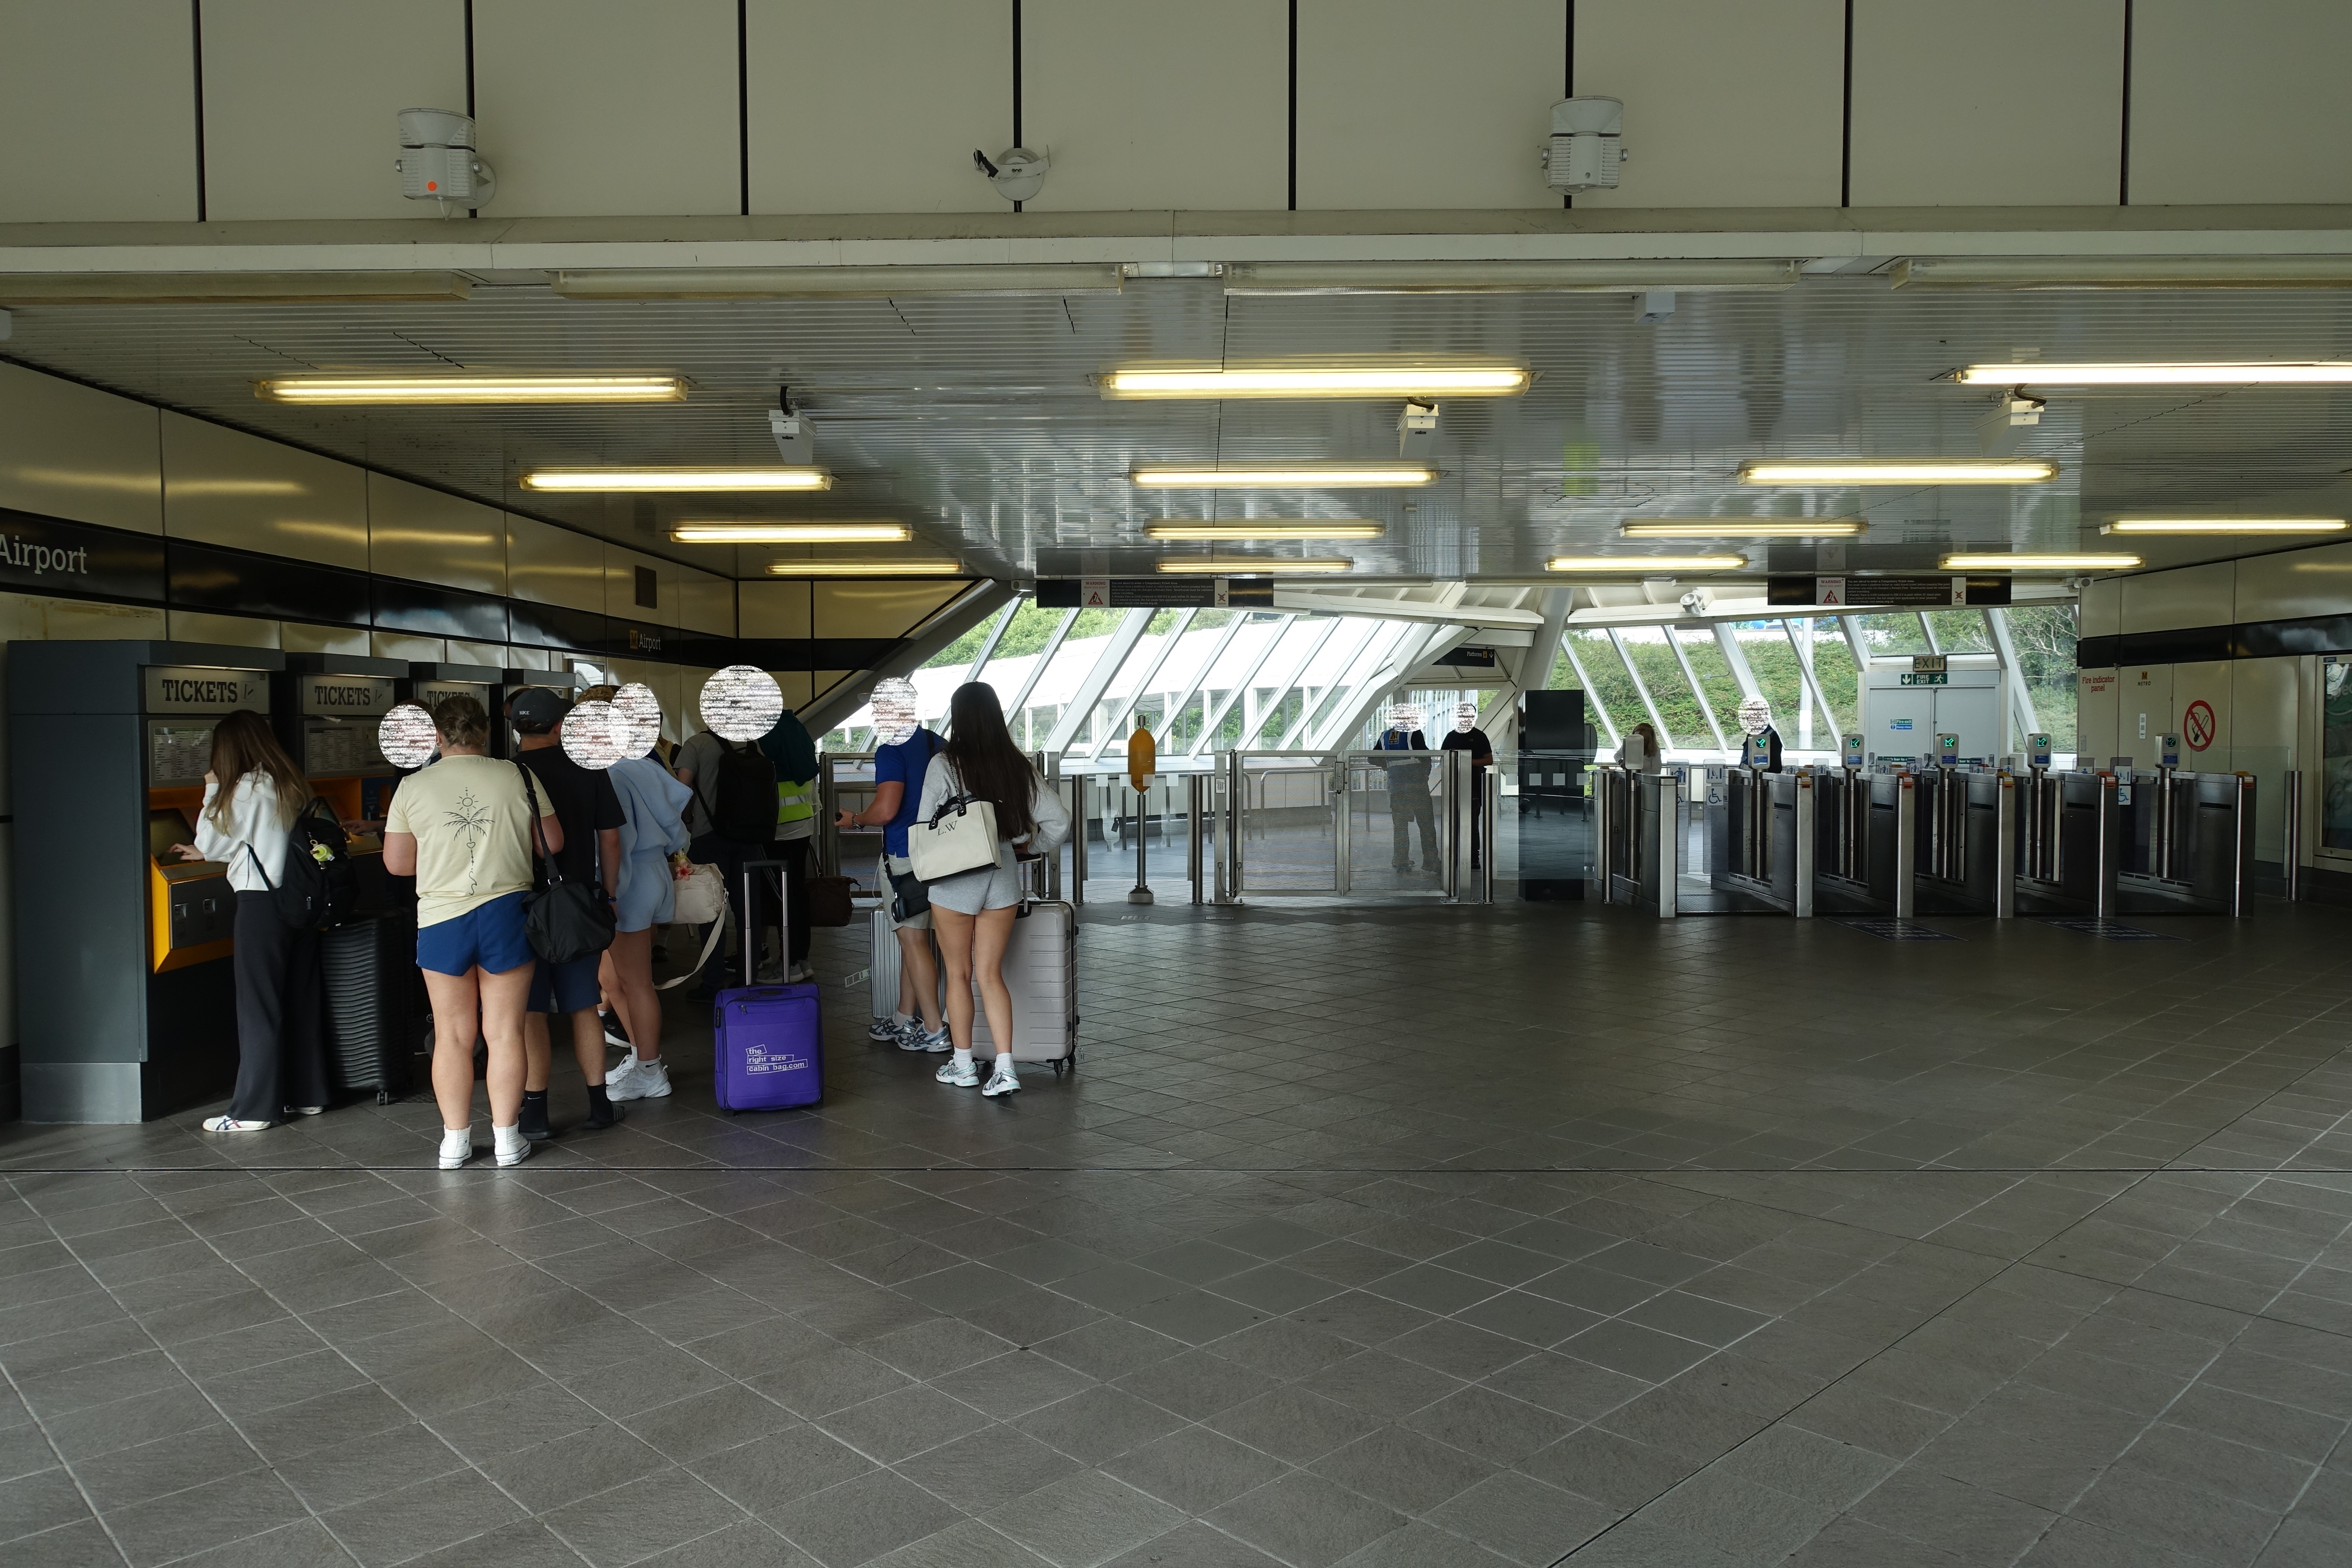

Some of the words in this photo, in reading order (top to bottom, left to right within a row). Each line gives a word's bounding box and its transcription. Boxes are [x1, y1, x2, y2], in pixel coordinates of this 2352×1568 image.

[0, 534, 87, 574] Airport
[639, 634, 661, 652] Airport
[1914, 658, 1944, 668] EXIT
[162, 679, 238, 703] TICKETS
[315, 686, 370, 706] TICKETS
[2091, 684, 2105, 693] panel
